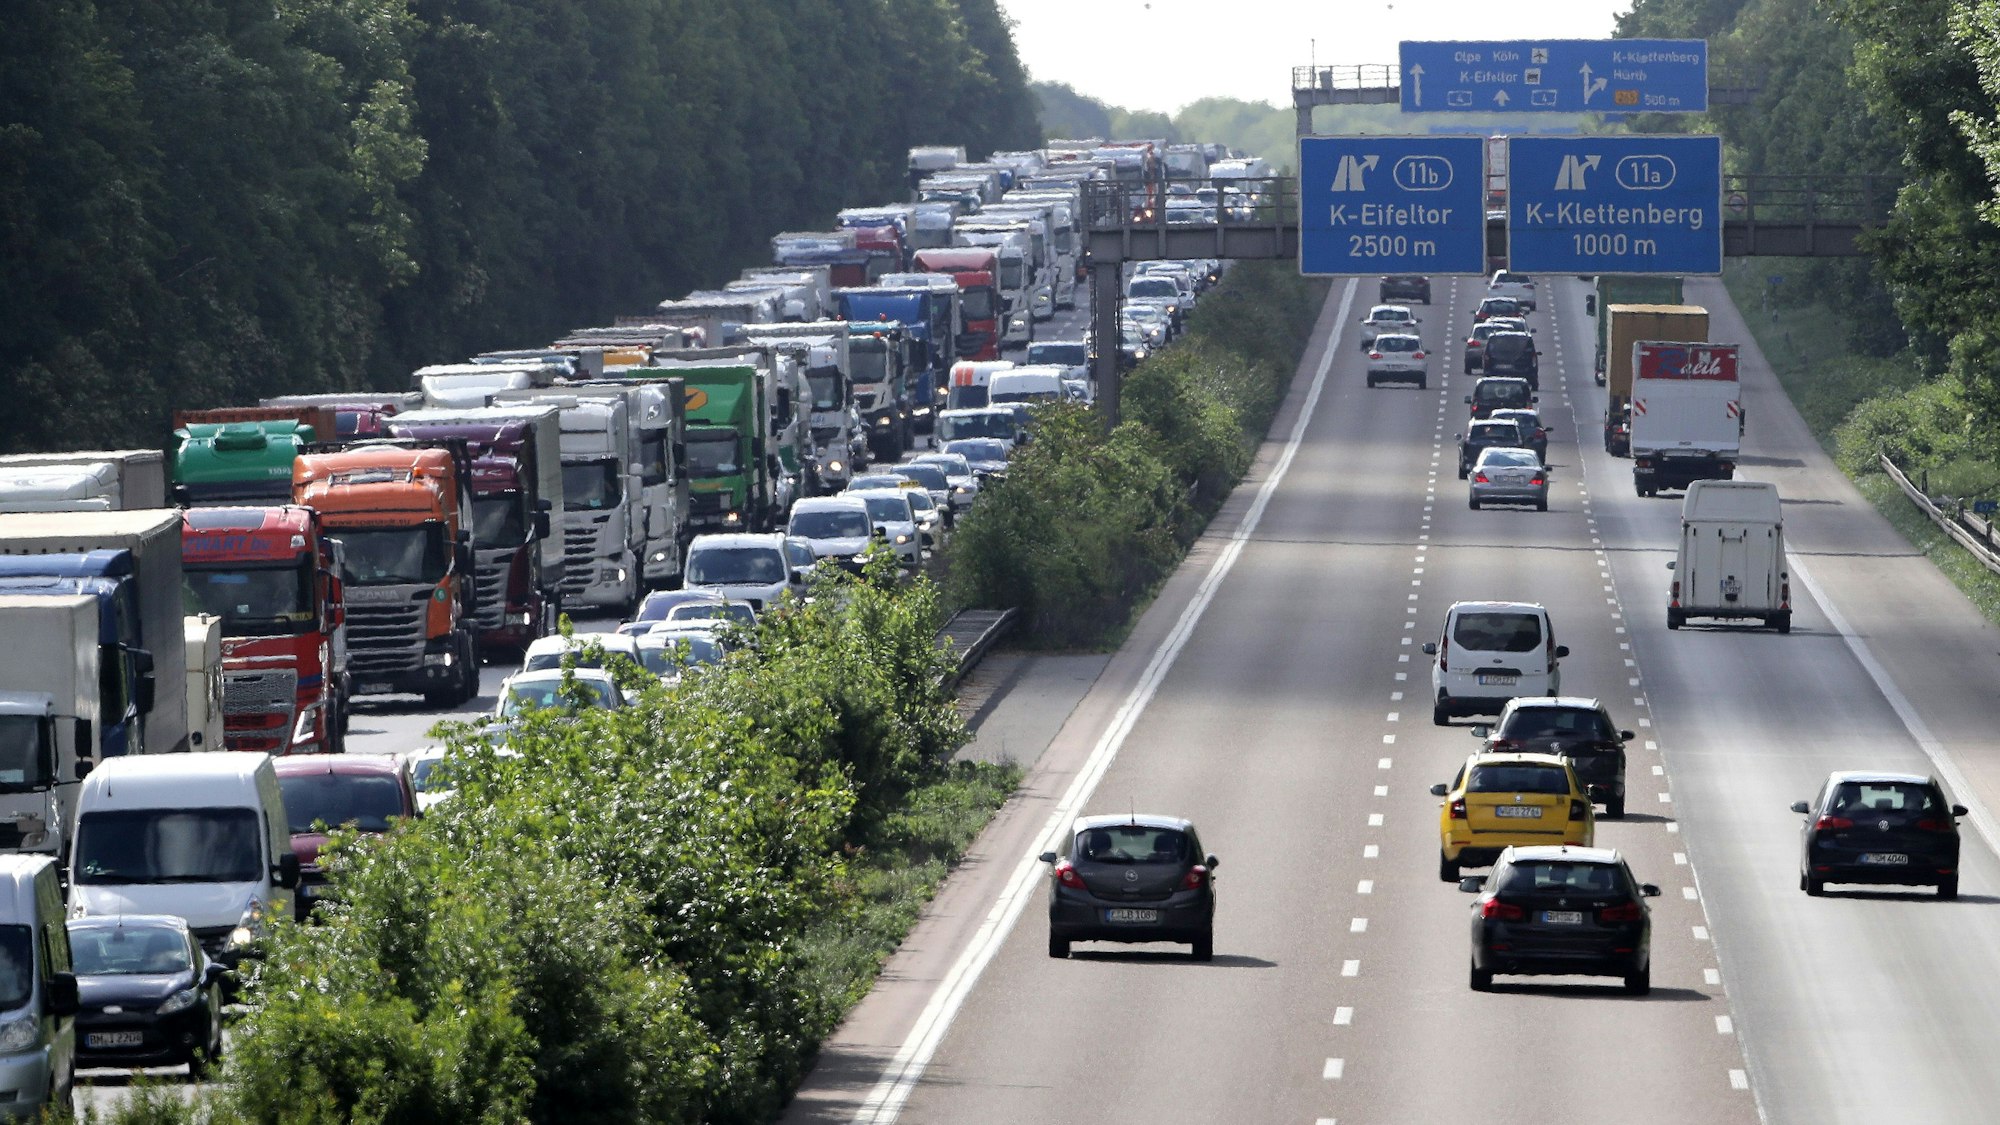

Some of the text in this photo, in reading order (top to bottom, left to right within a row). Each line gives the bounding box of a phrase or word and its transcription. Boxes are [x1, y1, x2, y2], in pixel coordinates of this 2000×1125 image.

[1454, 50, 1520, 65] Olpe Köln
[1612, 51, 1700, 65] K-Klettenberg
[1460, 70, 1519, 83] K-Eifeltor
[1668, 97, 1681, 106] m
[1408, 161, 1439, 184] 11b
[1631, 161, 1661, 183] 11a
[1330, 203, 1453, 226] K-Eifeltor
[1526, 202, 1703, 230] K-Klettenberg
[1349, 234, 1437, 258] 2500 m
[1573, 233, 1658, 256] 1000 m
